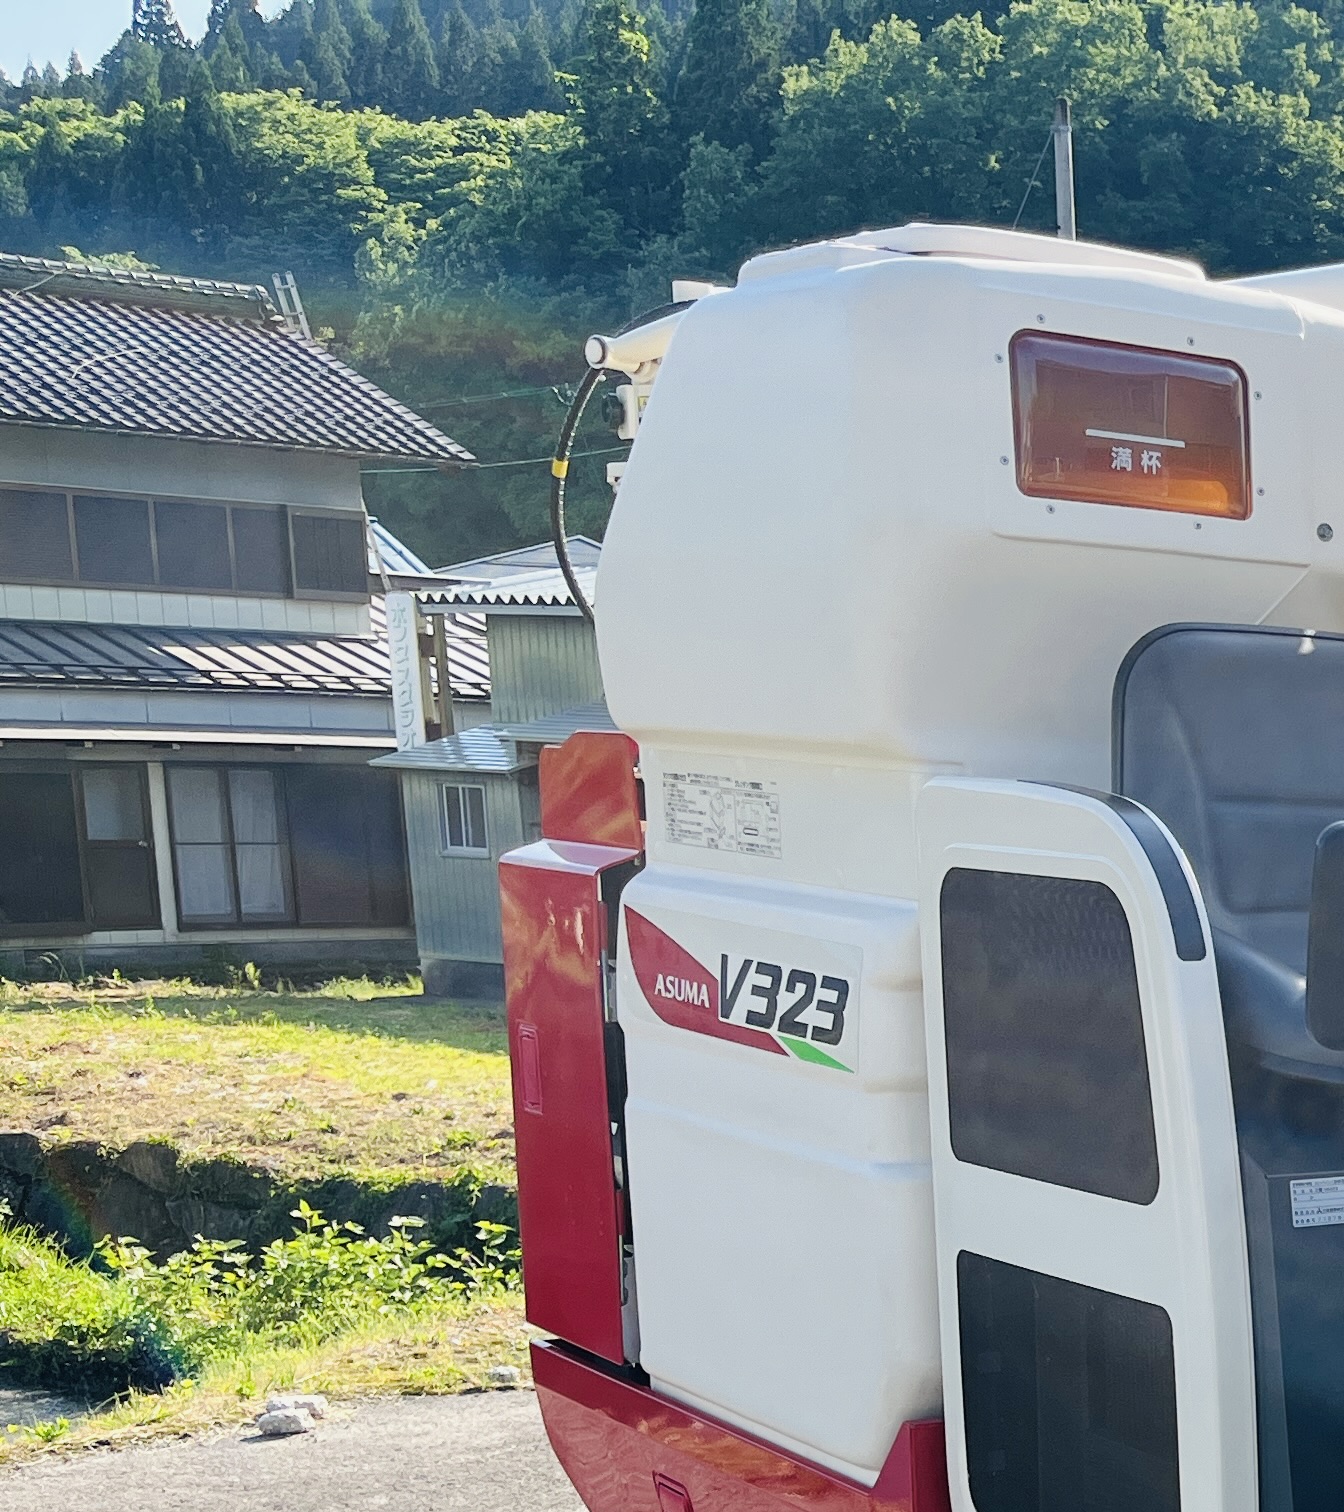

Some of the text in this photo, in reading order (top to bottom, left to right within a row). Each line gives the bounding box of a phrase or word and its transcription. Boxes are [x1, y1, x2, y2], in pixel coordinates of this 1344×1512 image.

[1111, 446, 1163, 475] 満杯
[654, 973, 711, 1009] ASUMA
[720, 953, 851, 1047] V323
